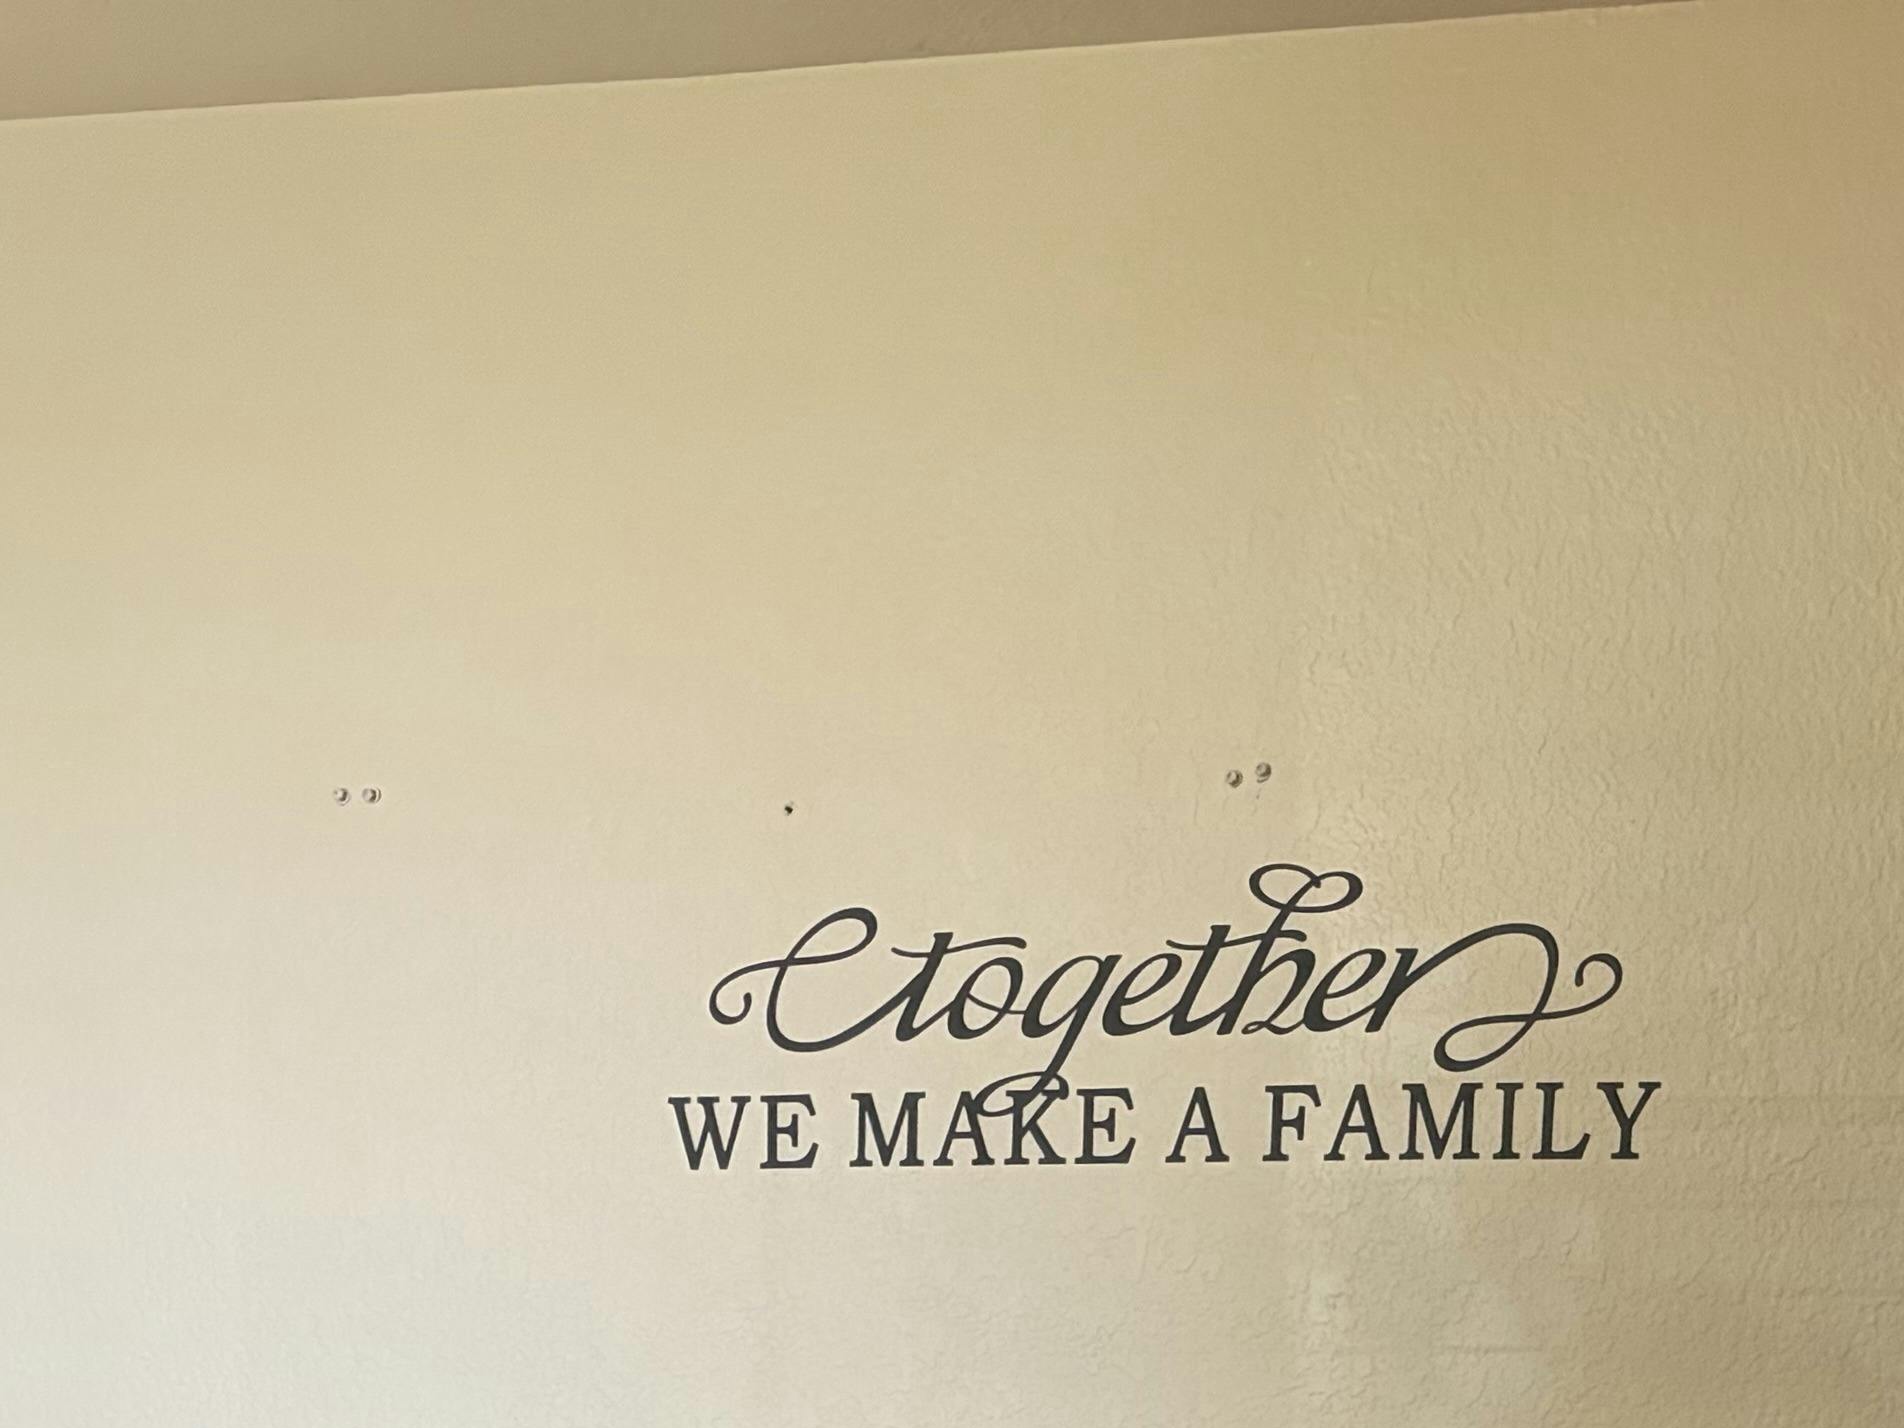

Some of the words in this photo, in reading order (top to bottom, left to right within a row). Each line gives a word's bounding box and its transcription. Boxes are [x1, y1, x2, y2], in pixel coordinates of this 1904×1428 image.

[709, 863, 1623, 1120] together
[667, 1094, 819, 1170] WE
[849, 1088, 1136, 1168] MAKE
[1165, 1086, 1230, 1163] A
[1262, 1081, 1662, 1162] FAMILY
